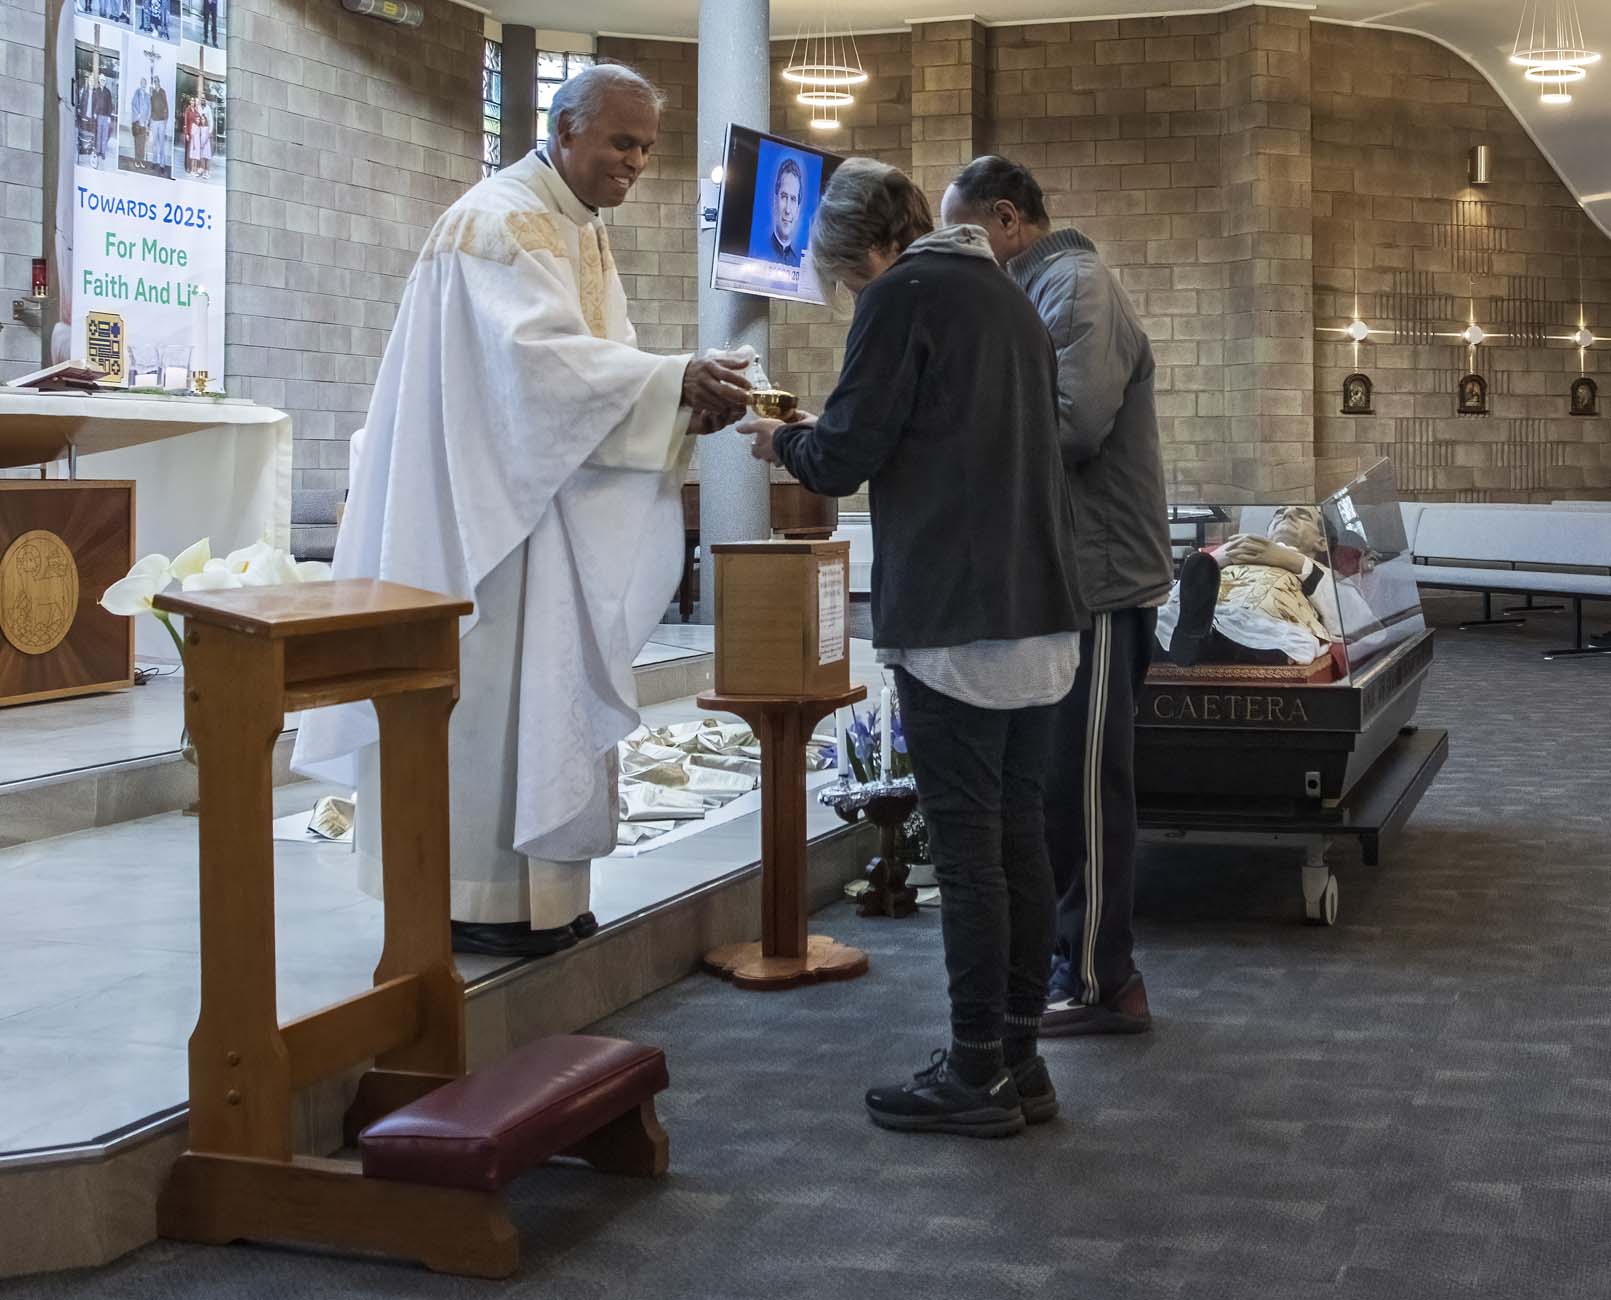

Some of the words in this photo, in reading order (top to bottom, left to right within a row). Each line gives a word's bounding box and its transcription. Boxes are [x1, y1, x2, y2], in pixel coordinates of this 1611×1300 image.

[77, 186, 157, 221] TOWARDS
[163, 203, 212, 230] 2025:
[105, 231, 136, 258] For
[142, 238, 188, 267] More
[83, 269, 129, 300] Faith
[134, 277, 170, 305] And
[177, 282, 208, 307] Li
[1153, 694, 1309, 721] CAETERA
